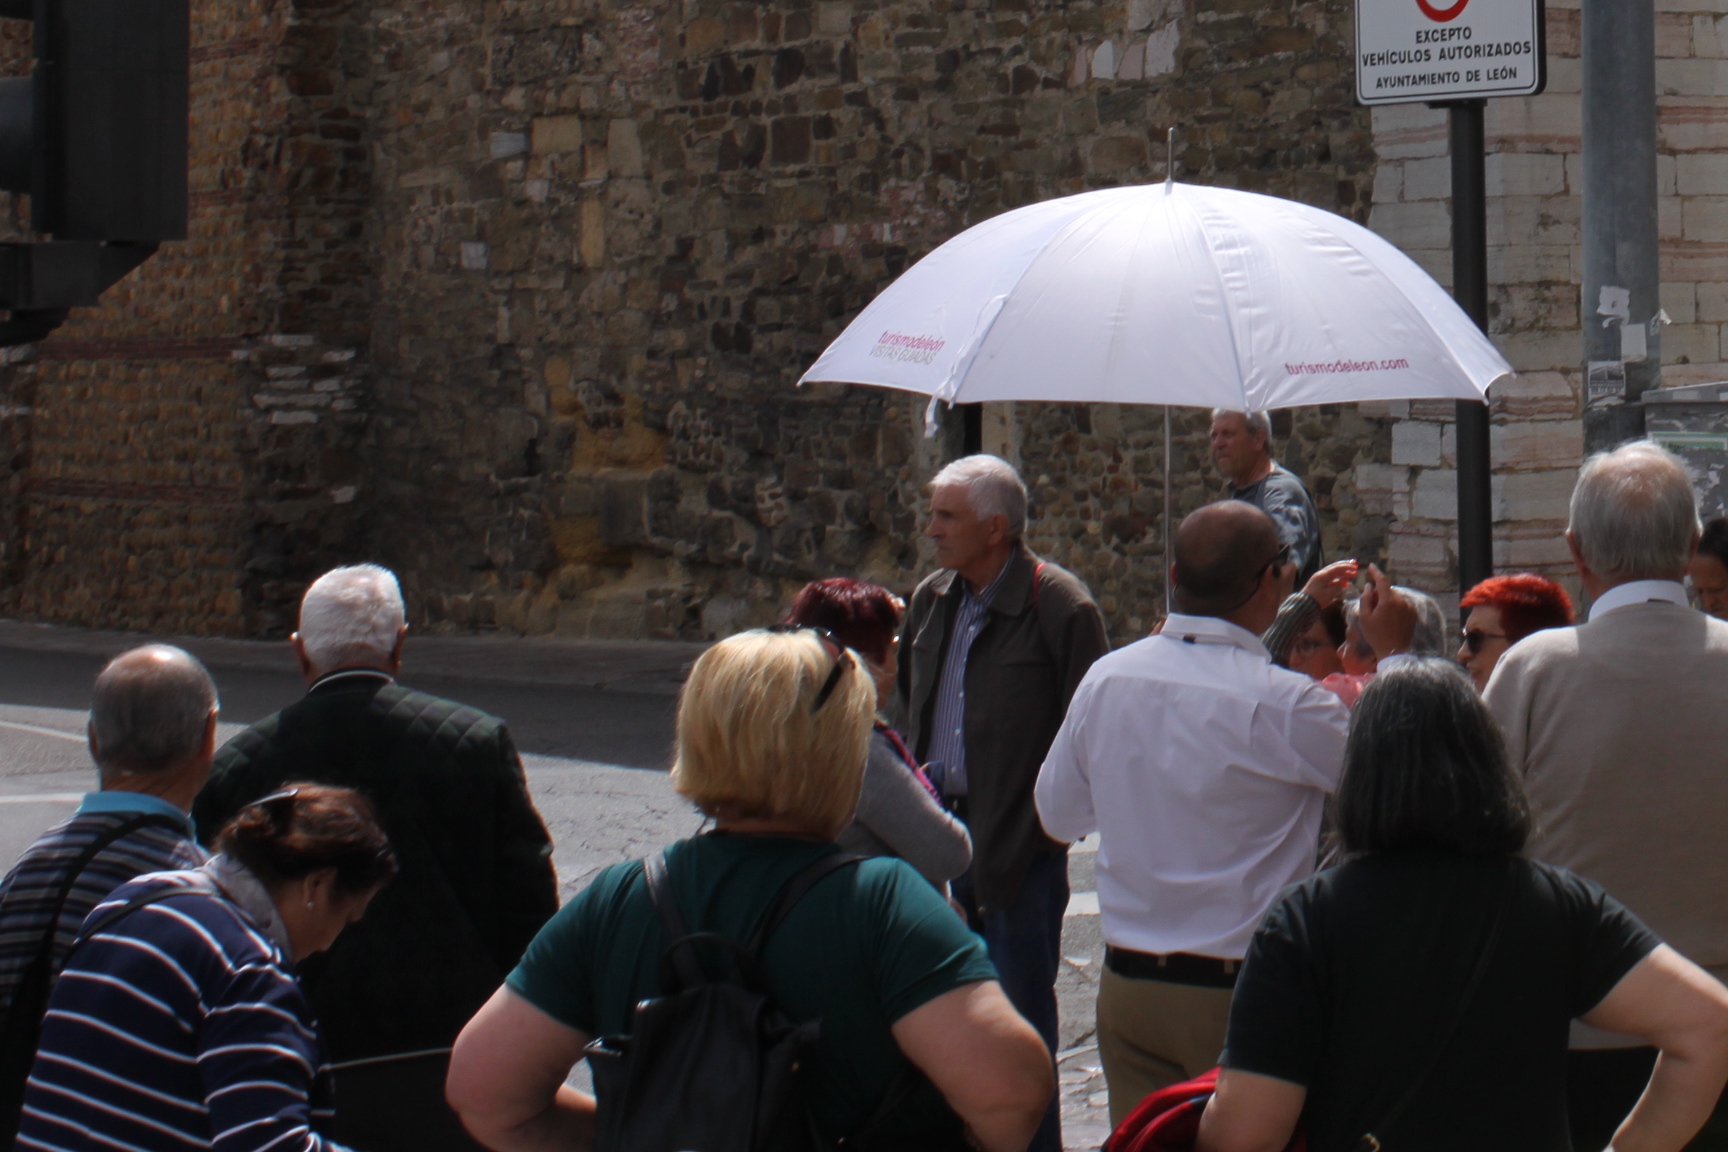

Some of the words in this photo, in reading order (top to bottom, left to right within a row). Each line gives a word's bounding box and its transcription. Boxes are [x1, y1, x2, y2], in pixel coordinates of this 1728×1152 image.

[1415, 26, 1472, 44] EXCEPTO
[1362, 49, 1432, 67] VEHÍCULOS
[1438, 41, 1532, 62] AUTORIZADOS
[1375, 72, 1461, 89] AYUNTAMIENTO
[1466, 70, 1481, 82] DE
[1487, 65, 1518, 81] LEÓN
[1284, 358, 1410, 376] turismodeleon.com
